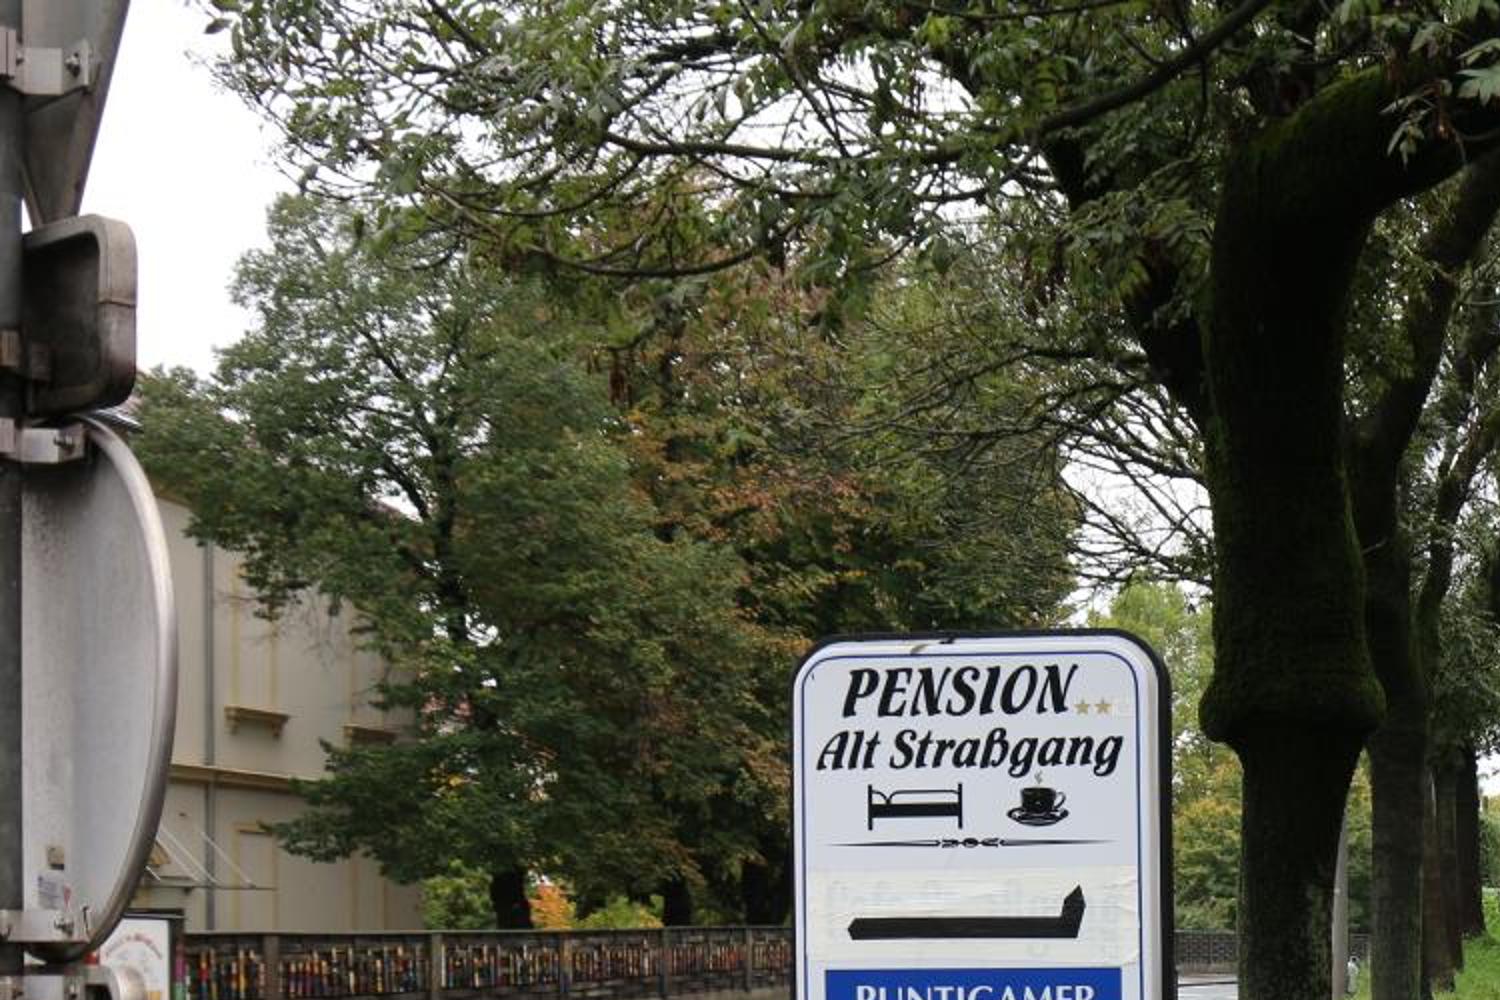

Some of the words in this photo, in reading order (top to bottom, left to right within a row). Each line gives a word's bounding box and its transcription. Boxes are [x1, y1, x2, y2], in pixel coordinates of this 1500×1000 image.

[842, 663, 1079, 718] PENSION
[816, 730, 881, 771] Alt
[889, 727, 1124, 778] Straßgang
